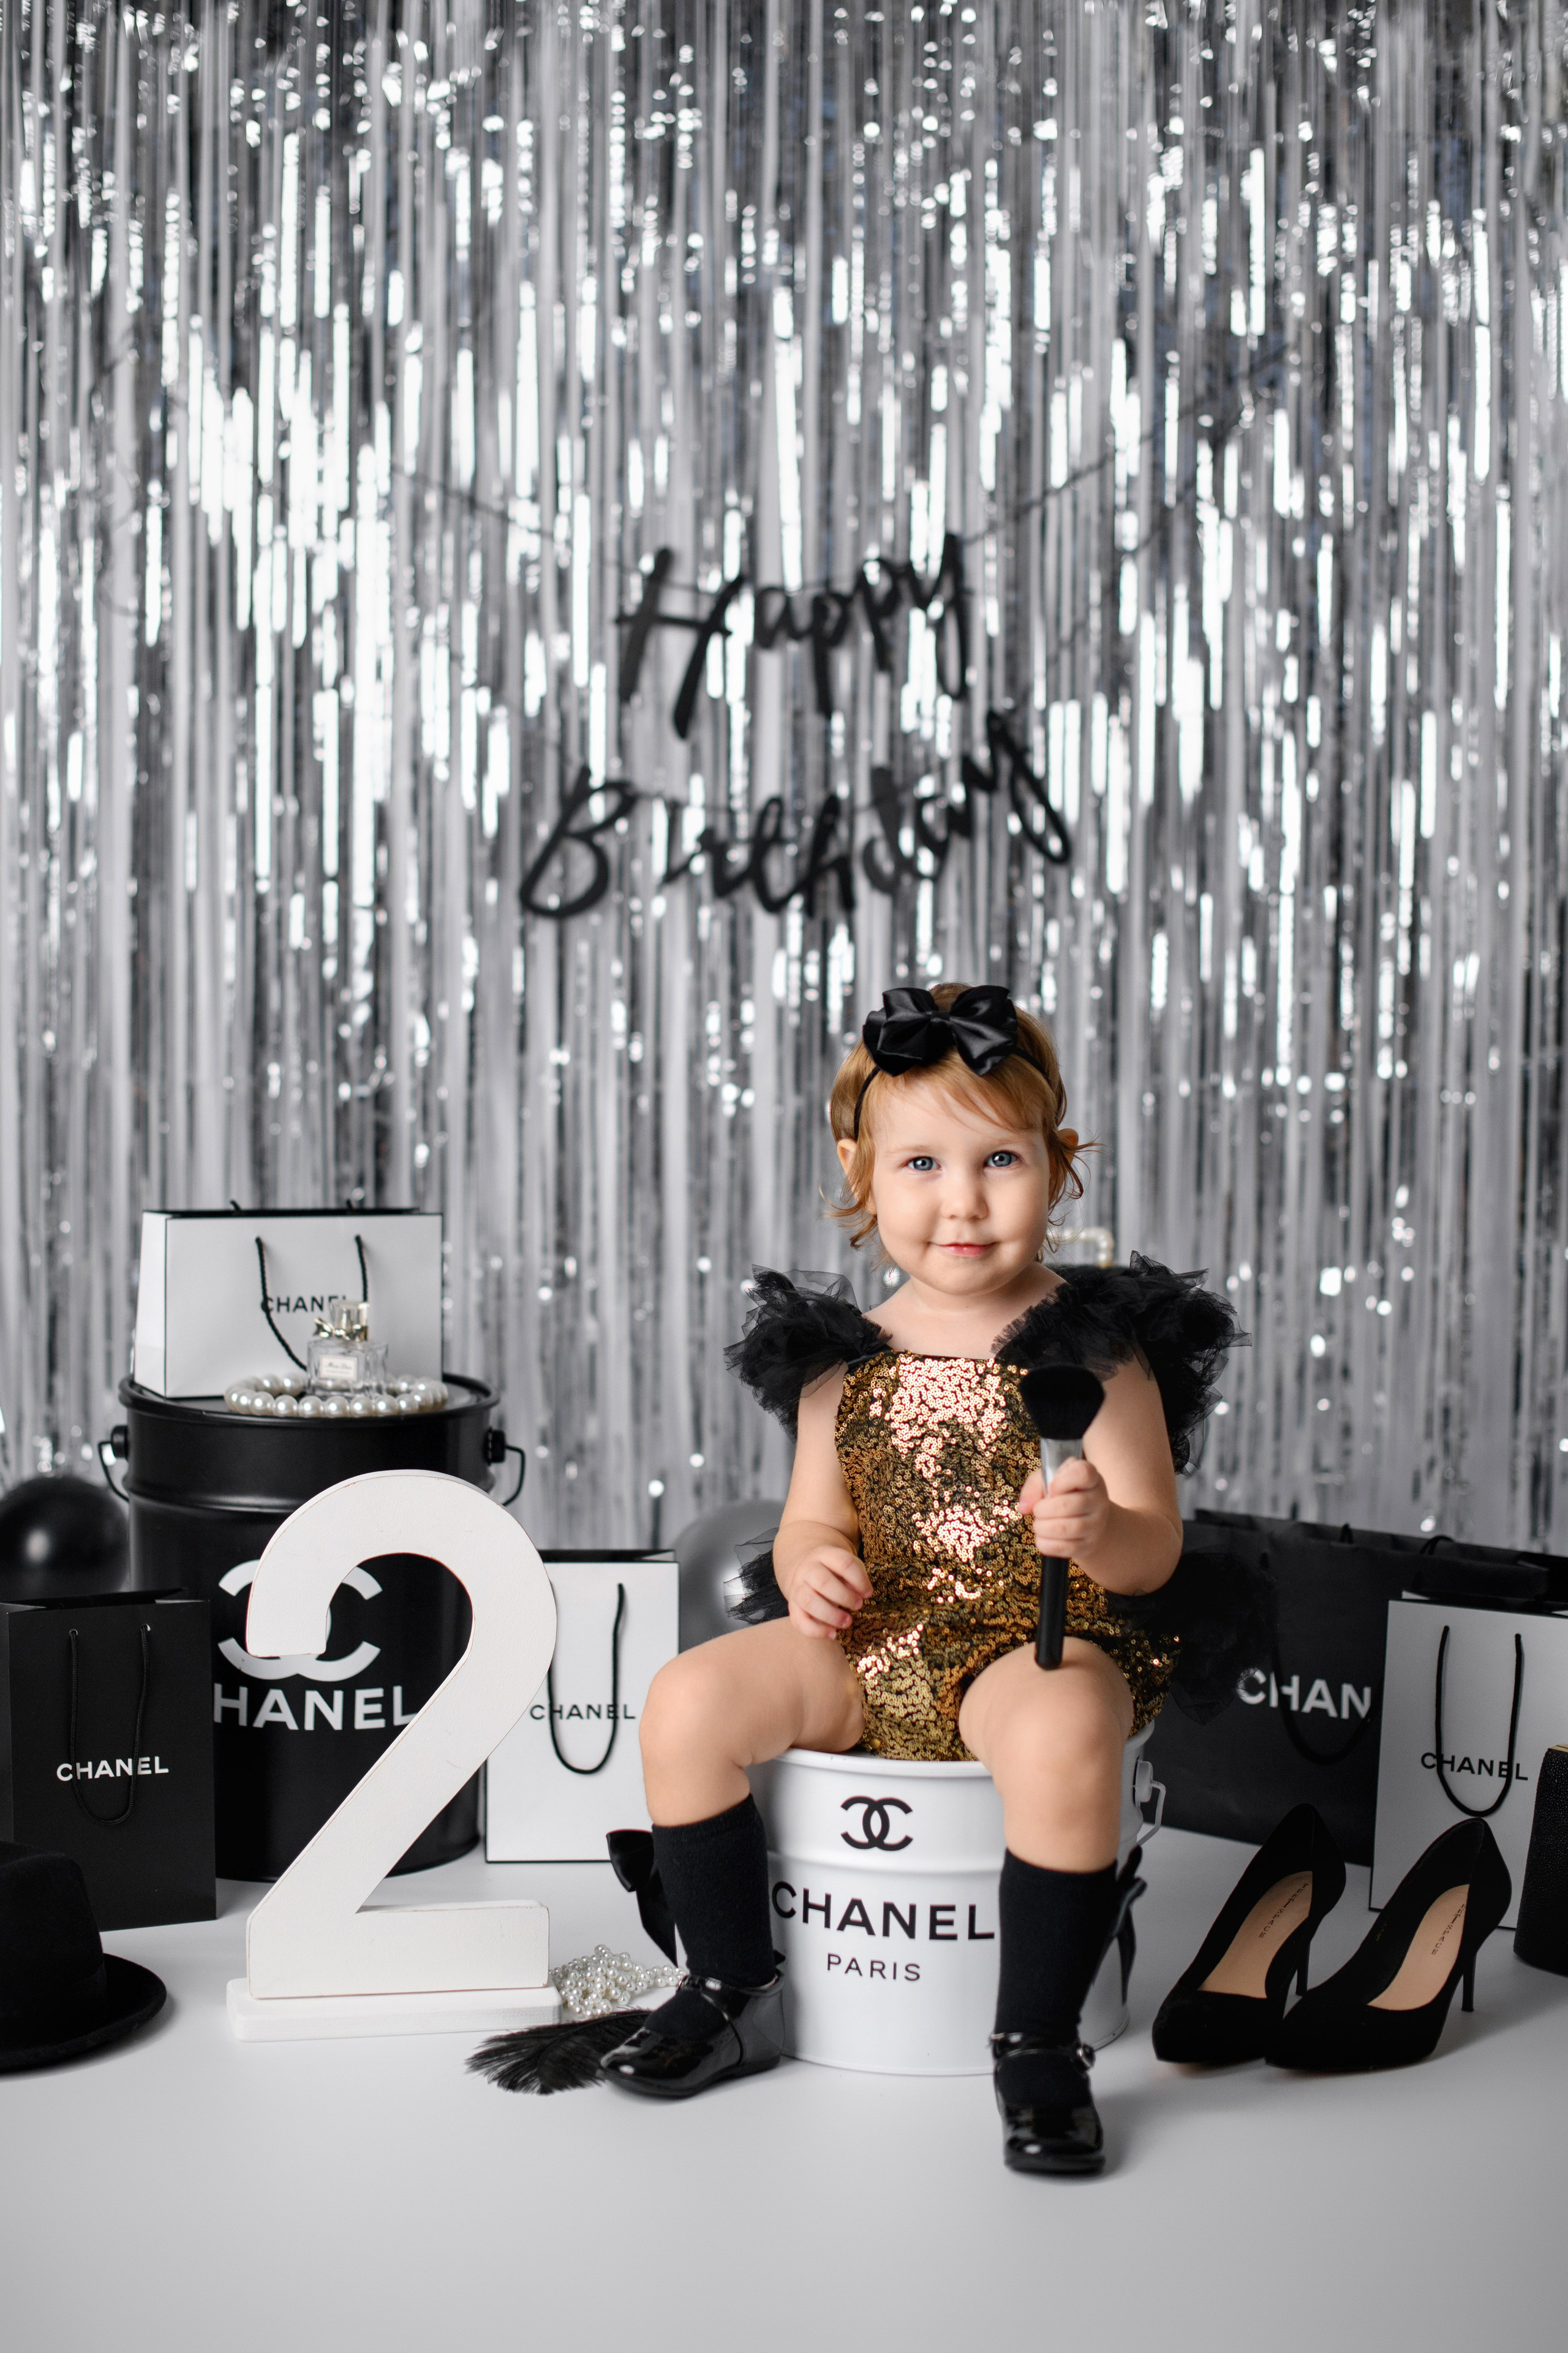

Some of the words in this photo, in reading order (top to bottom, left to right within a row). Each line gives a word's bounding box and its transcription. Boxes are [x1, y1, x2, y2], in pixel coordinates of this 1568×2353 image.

[616, 531, 969, 740] Happy
[262, 1295, 347, 1313] CHAN
[213, 1683, 418, 1731] HANEL
[529, 1704, 636, 1721] CHANEL
[1236, 1667, 1372, 1720] CHAN
[246, 1468, 557, 1999] 2
[56, 1756, 169, 1781] CHANEL
[1420, 1753, 1529, 1781] CHANEL
[771, 1881, 996, 1941] CHANEL
[1431, 1902, 1468, 1955] EETSPACE
[826, 1952, 921, 1982] PARIS
